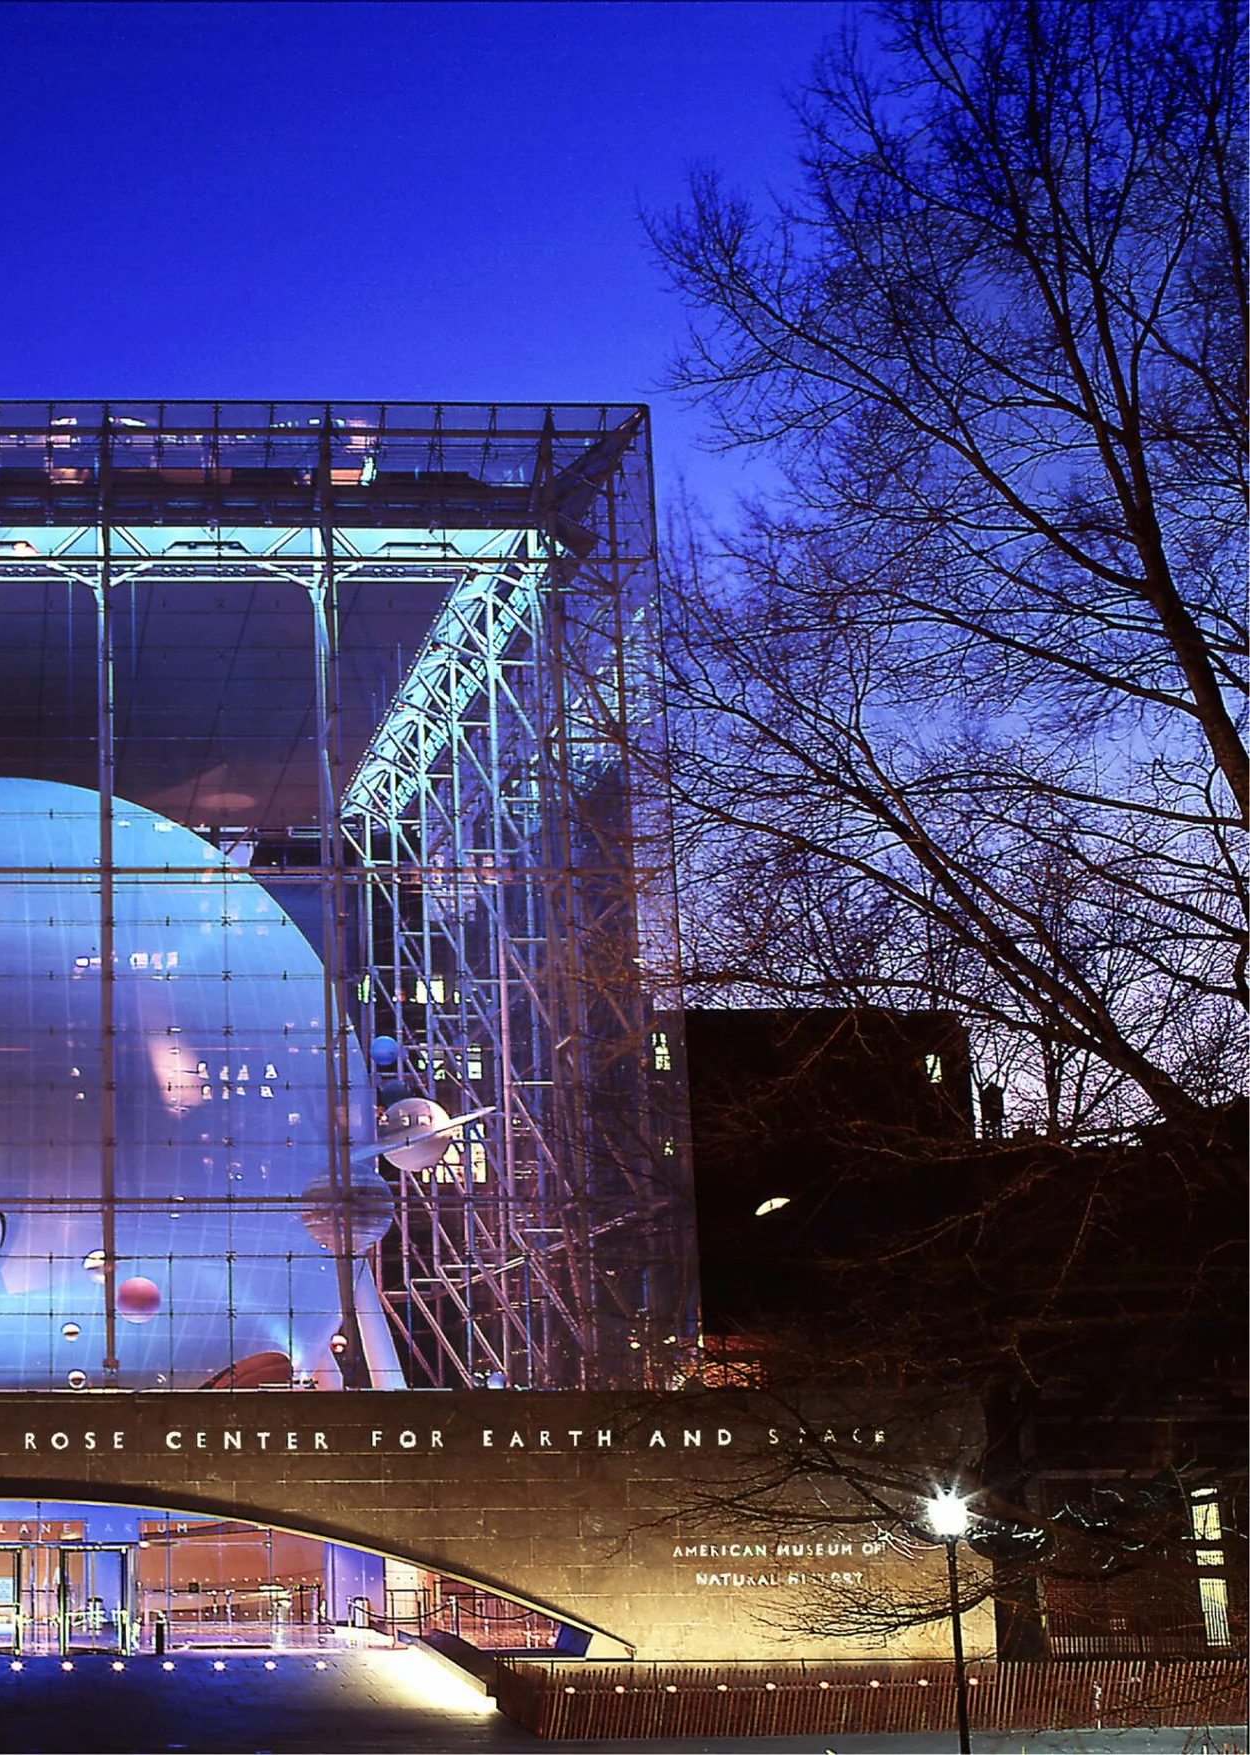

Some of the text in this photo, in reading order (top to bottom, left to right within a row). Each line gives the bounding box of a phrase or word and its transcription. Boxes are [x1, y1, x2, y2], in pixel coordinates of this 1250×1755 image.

[24, 1431, 126, 1450] ROSE
[165, 1430, 329, 1450] CENTER
[371, 1430, 445, 1449] FOR
[482, 1429, 612, 1448] EARTH
[649, 1428, 733, 1448] AND
[672, 1541, 881, 1558] AMERICAN MUSEUM OF
